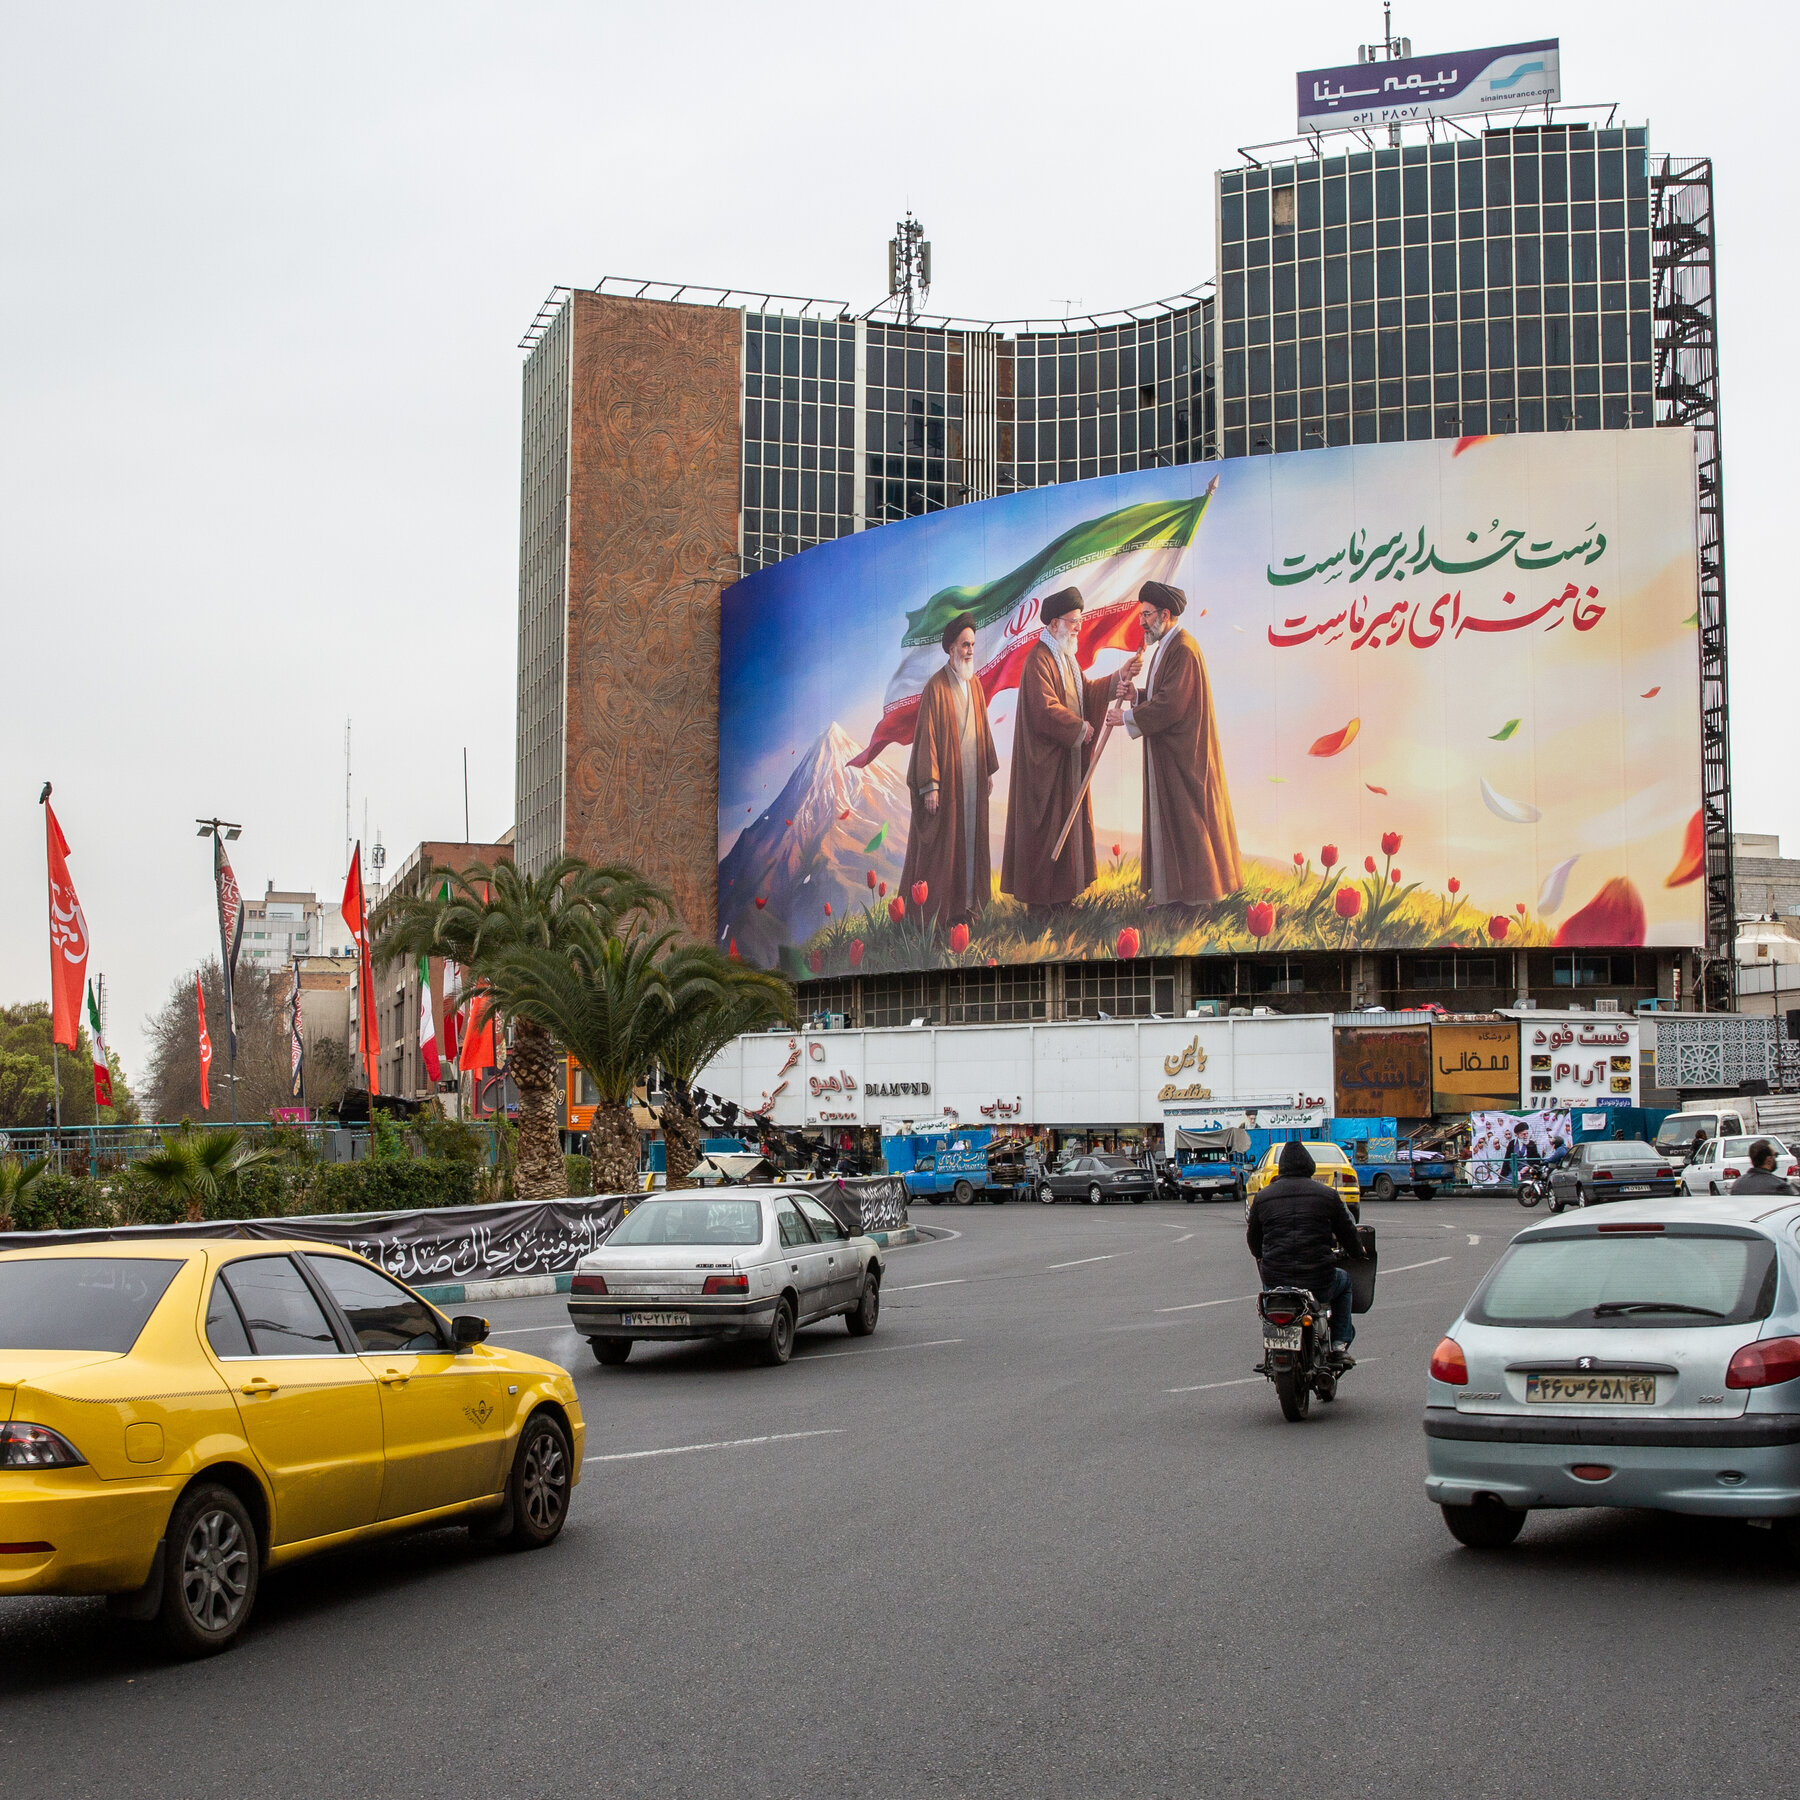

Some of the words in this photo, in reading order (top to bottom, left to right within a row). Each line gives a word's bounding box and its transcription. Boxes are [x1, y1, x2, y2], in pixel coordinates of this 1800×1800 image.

[1313, 79, 1380, 106] سینا
[1384, 69, 1458, 95] بیمه
[1480, 88, 1555, 102] sinainsurance.com
[1353, 112, 1374, 123] ۰۲۱
[1382, 107, 1418, 121] ۲۸۰۷
[1350, 598, 1409, 651] رهبر
[1478, 1032, 1512, 1043] فروشگاه
[1533, 1022, 1574, 1051] فود
[1578, 1023, 1630, 1046] فست
[1164, 1034, 1208, 1077] بالین
[808, 1069, 858, 1102] بامبو
[1555, 1061, 1607, 1087] آرام
[1158, 1083, 1212, 1102] Balin
[979, 1095, 1022, 1119] زیبایی
